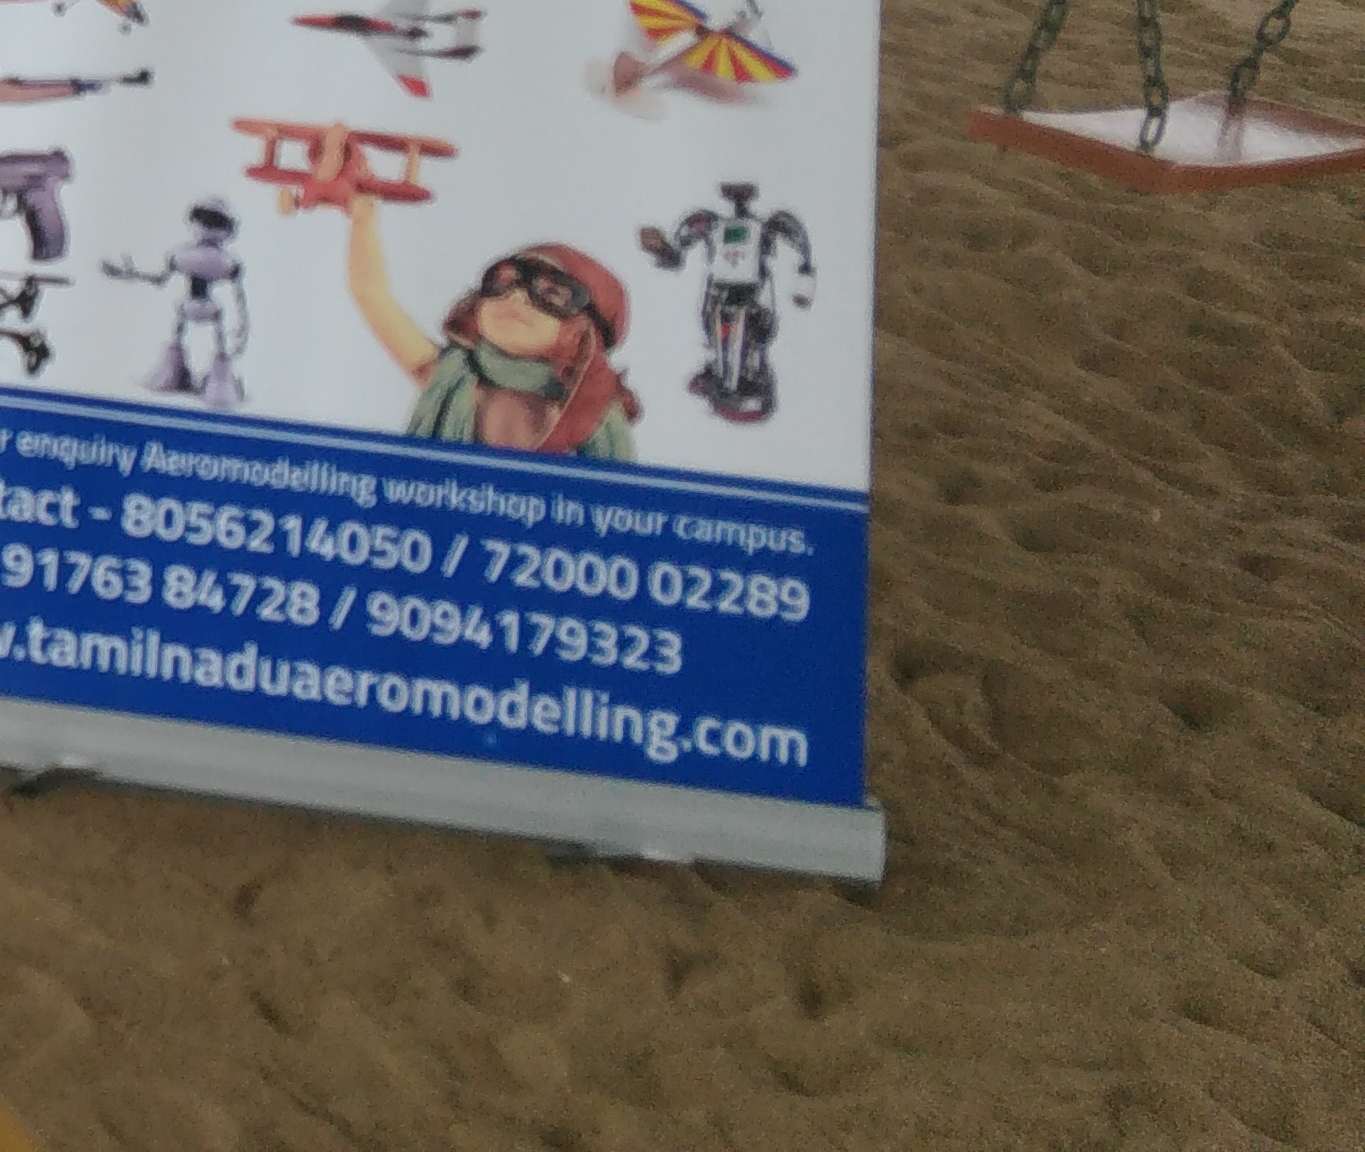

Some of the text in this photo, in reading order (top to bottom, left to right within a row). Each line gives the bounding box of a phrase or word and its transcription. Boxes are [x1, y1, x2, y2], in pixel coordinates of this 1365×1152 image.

[15, 429, 138, 478] enquiry
[140, 439, 377, 508] Aeromodelling
[382, 475, 546, 529] workshop
[551, 490, 585, 528] in
[592, 504, 667, 538] your
[672, 514, 814, 556] campus.
[121, 491, 432, 574] 8056214050
[440, 533, 470, 578] /
[480, 537, 639, 602] 72000
[648, 560, 810, 622] 02289
[1, 542, 683, 675] 91763 84728 / 9094179323
